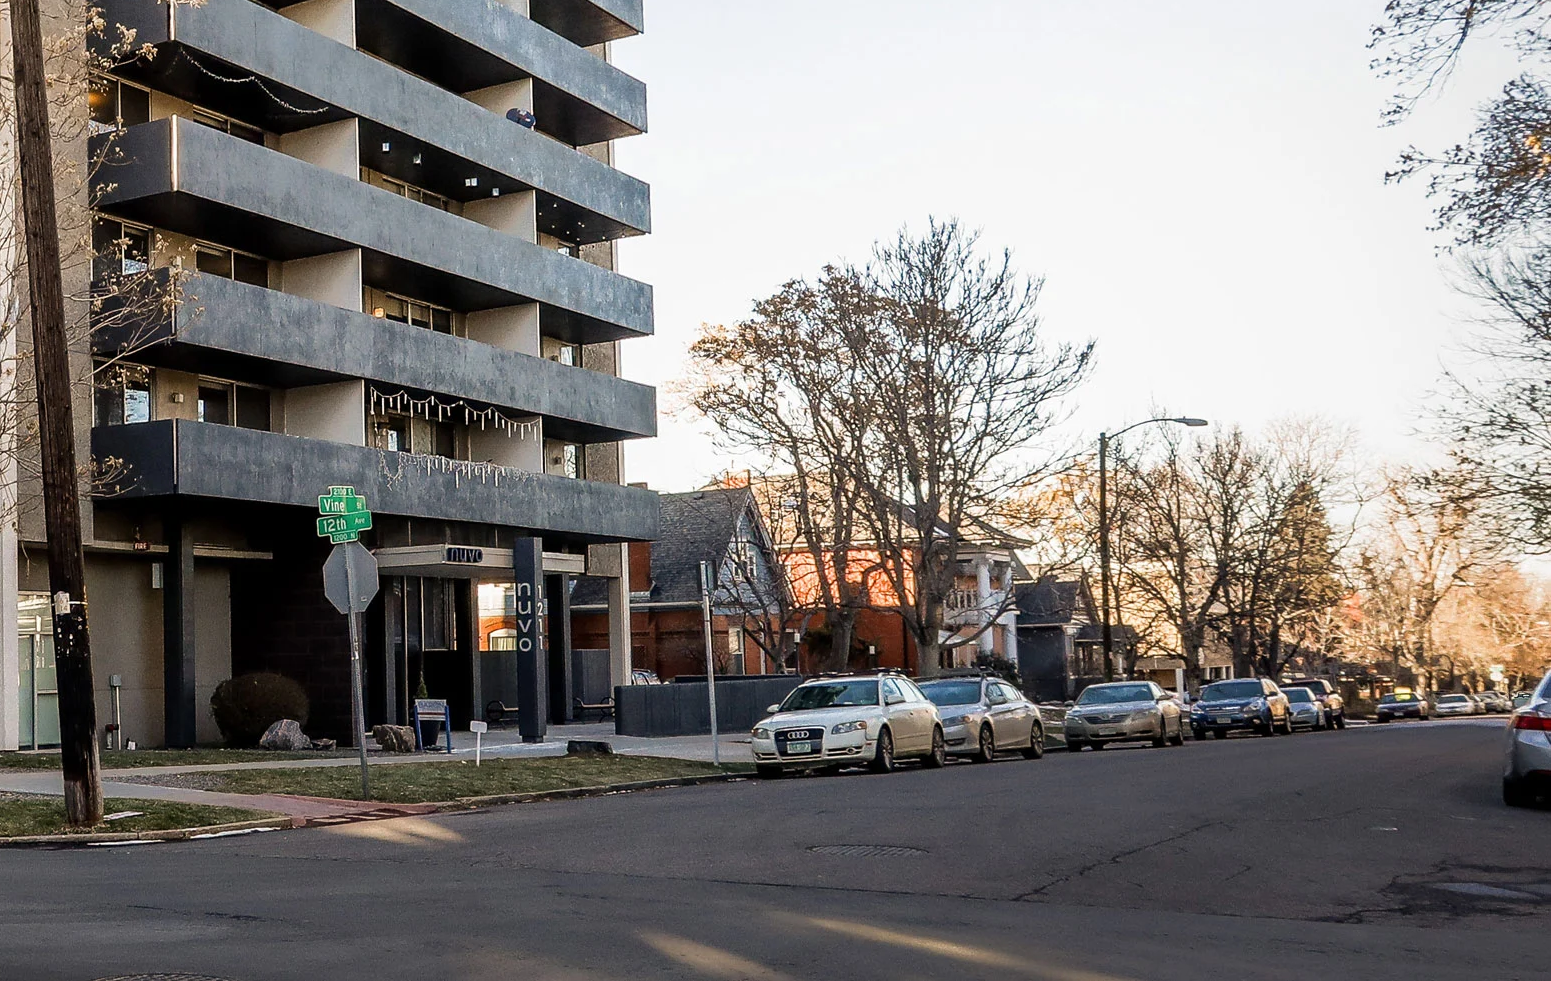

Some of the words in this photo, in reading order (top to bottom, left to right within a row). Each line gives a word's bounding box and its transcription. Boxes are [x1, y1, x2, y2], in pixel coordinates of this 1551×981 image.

[348, 488, 352, 496] E
[323, 498, 345, 512] Vine
[356, 502, 363, 510] St
[323, 517, 347, 533] 12th
[354, 517, 365, 525] Ave
[333, 533, 348, 541] 1200
[450, 548, 483, 563] nuvo
[517, 582, 532, 652] nuvo
